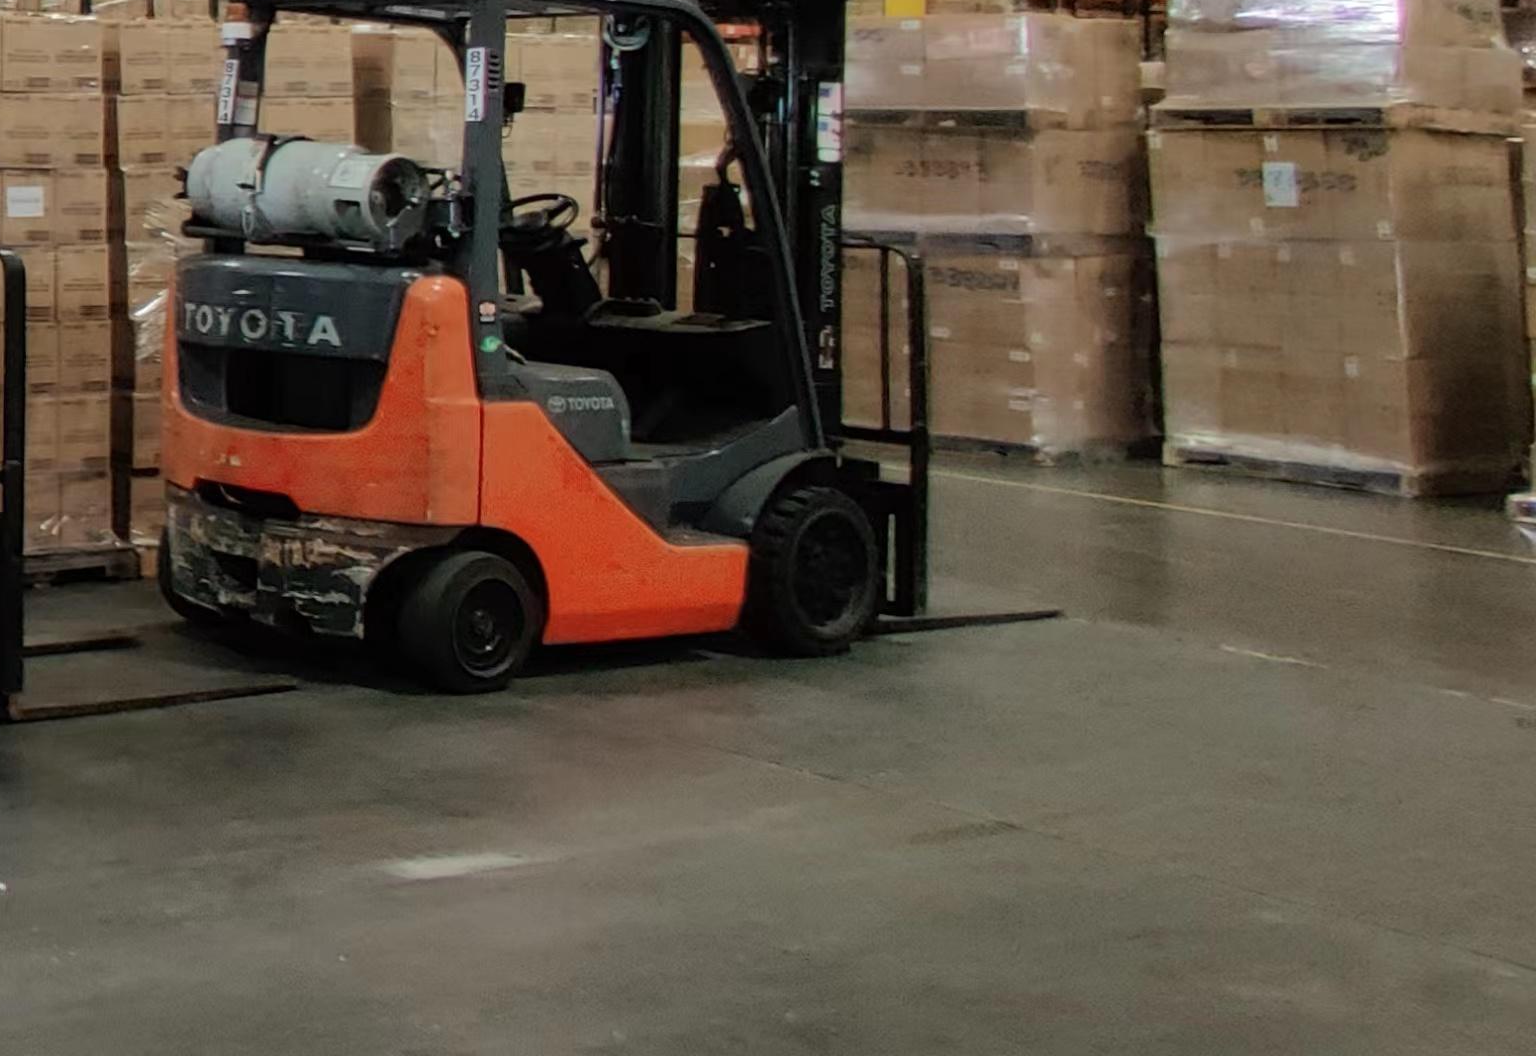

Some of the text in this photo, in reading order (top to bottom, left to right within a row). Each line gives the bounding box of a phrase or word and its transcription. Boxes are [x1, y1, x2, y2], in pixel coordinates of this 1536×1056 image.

[218, 61, 235, 122] 87314
[468, 51, 481, 120] 87314
[820, 204, 837, 312] TOYOTA
[184, 303, 343, 347] TOYOTA
[567, 396, 615, 411] TOYOTA
